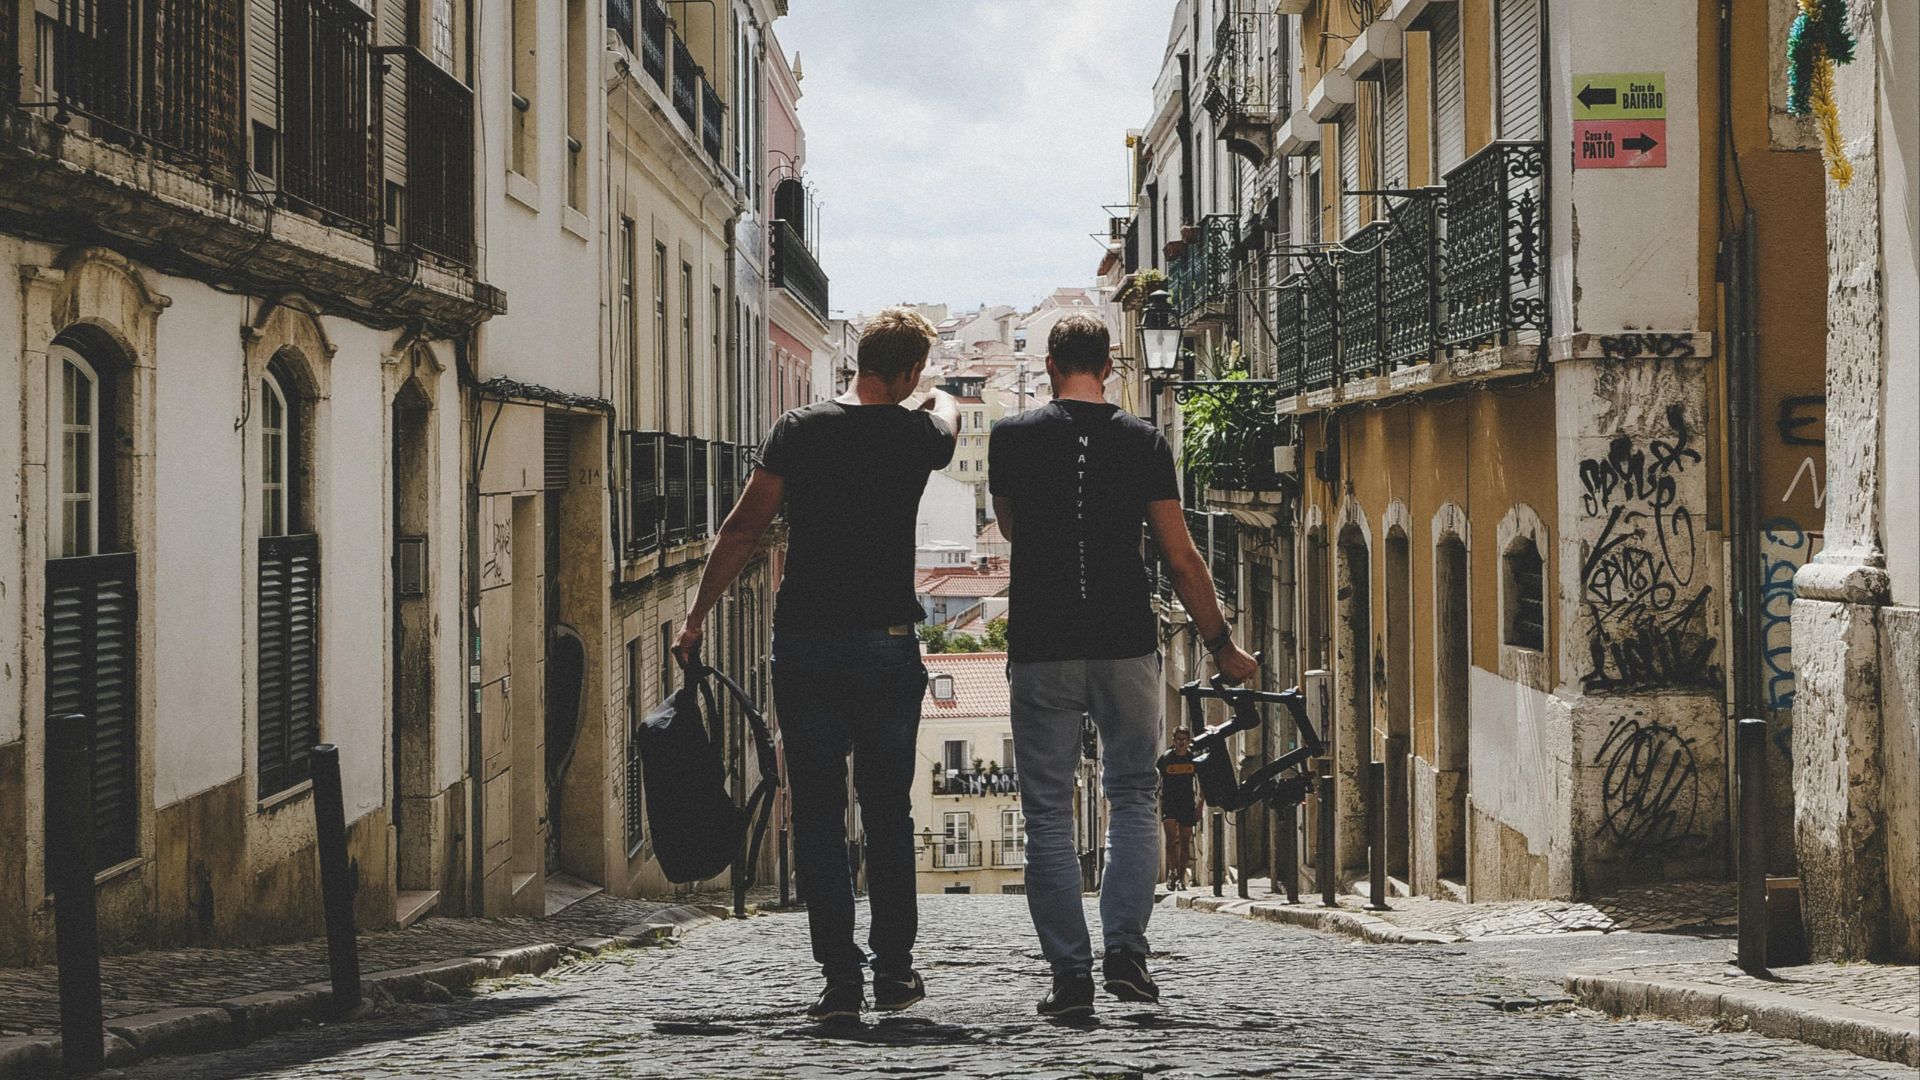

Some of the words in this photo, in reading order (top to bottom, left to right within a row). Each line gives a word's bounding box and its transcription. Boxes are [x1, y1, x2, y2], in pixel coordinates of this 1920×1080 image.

[1630, 83, 1646, 92] Casa
[1622, 93, 1663, 109] BAIRRO
[1584, 130, 1602, 141] Casa
[1582, 142, 1615, 159] PATIO
